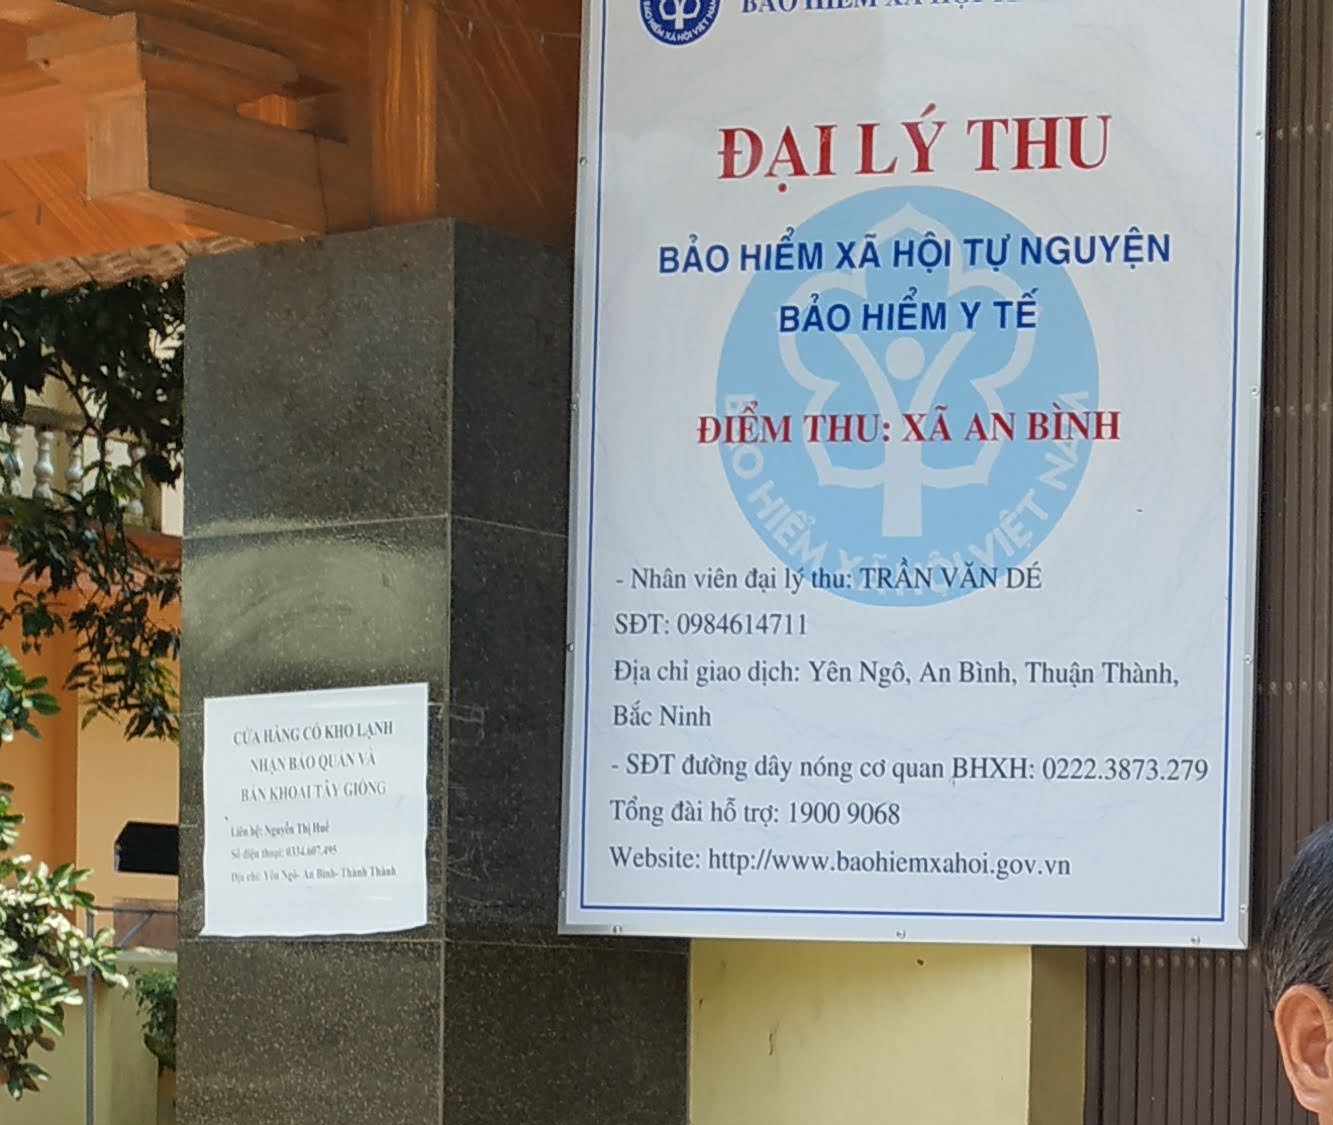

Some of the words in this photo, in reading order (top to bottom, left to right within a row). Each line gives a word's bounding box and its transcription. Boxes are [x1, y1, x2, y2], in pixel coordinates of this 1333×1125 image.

[717, 124, 838, 193] ĐẠI
[855, 103, 947, 174] LÝ
[966, 115, 1112, 171] THU
[659, 233, 730, 273] BẢO
[740, 227, 823, 271] HIỂM
[835, 233, 881, 269] XÃ
[893, 231, 950, 273] HỘI
[963, 234, 1011, 272] TỰ
[1021, 226, 1170, 270] NGUYỆN
[779, 293, 850, 333] BẢO
[862, 287, 946, 331] HIỂM
[960, 301, 981, 329] Y
[993, 288, 1039, 329] TẾ
[697, 400, 792, 445] ĐIỂM
[804, 413, 891, 444] THU:
[902, 405, 953, 443] XÃ
[964, 412, 1016, 442] AN
[1026, 402, 1121, 442] BÌNH
[631, 567, 687, 589] Nhân
[693, 567, 738, 589] viên
[744, 566, 777, 594] đại
[784, 566, 805, 595] lý
[811, 566, 852, 589] thu:
[858, 556, 932, 589] TRẦN
[940, 560, 999, 589] VĂN
[1006, 560, 1042, 589] DÉ
[614, 612, 670, 635] SĐT:
[676, 612, 806, 635] 0984614711
[614, 659, 651, 686] Địa
[656, 658, 689, 682] chỉ
[695, 659, 742, 688] giao
[747, 659, 800, 687] dịch:
[808, 660, 852, 683] Yên
[859, 660, 911, 689] Ngô,
[919, 661, 951, 683] An
[958, 660, 1017, 686] Bình,
[1024, 661, 1095, 689] Thuận
[1101, 661, 1179, 688] Thành,
[613, 699, 653, 727] Bắc
[659, 704, 711, 727] Ninh
[325, 723, 354, 740] KHO
[357, 720, 393, 740] LẠNH
[626, 753, 676, 775] SĐT
[681, 753, 748, 782] đường
[754, 754, 793, 783] dây
[800, 755, 853, 784] nóng
[859, 758, 886, 778] cơ
[891, 762, 944, 784] quan
[951, 756, 1035, 785] BHXH:
[1042, 757, 1209, 782] 0222.3873.279
[270, 784, 311, 801] KHOAI
[609, 795, 664, 828] Tổng
[670, 799, 703, 822] đài
[710, 796, 737, 823] hỗ
[743, 804, 779, 828] trợ:
[790, 801, 841, 825] 1900
[846, 802, 901, 826] 9068
[608, 846, 700, 869] Website:
[708, 847, 1071, 881] http://www.baohiemxahoi.gov.vn
